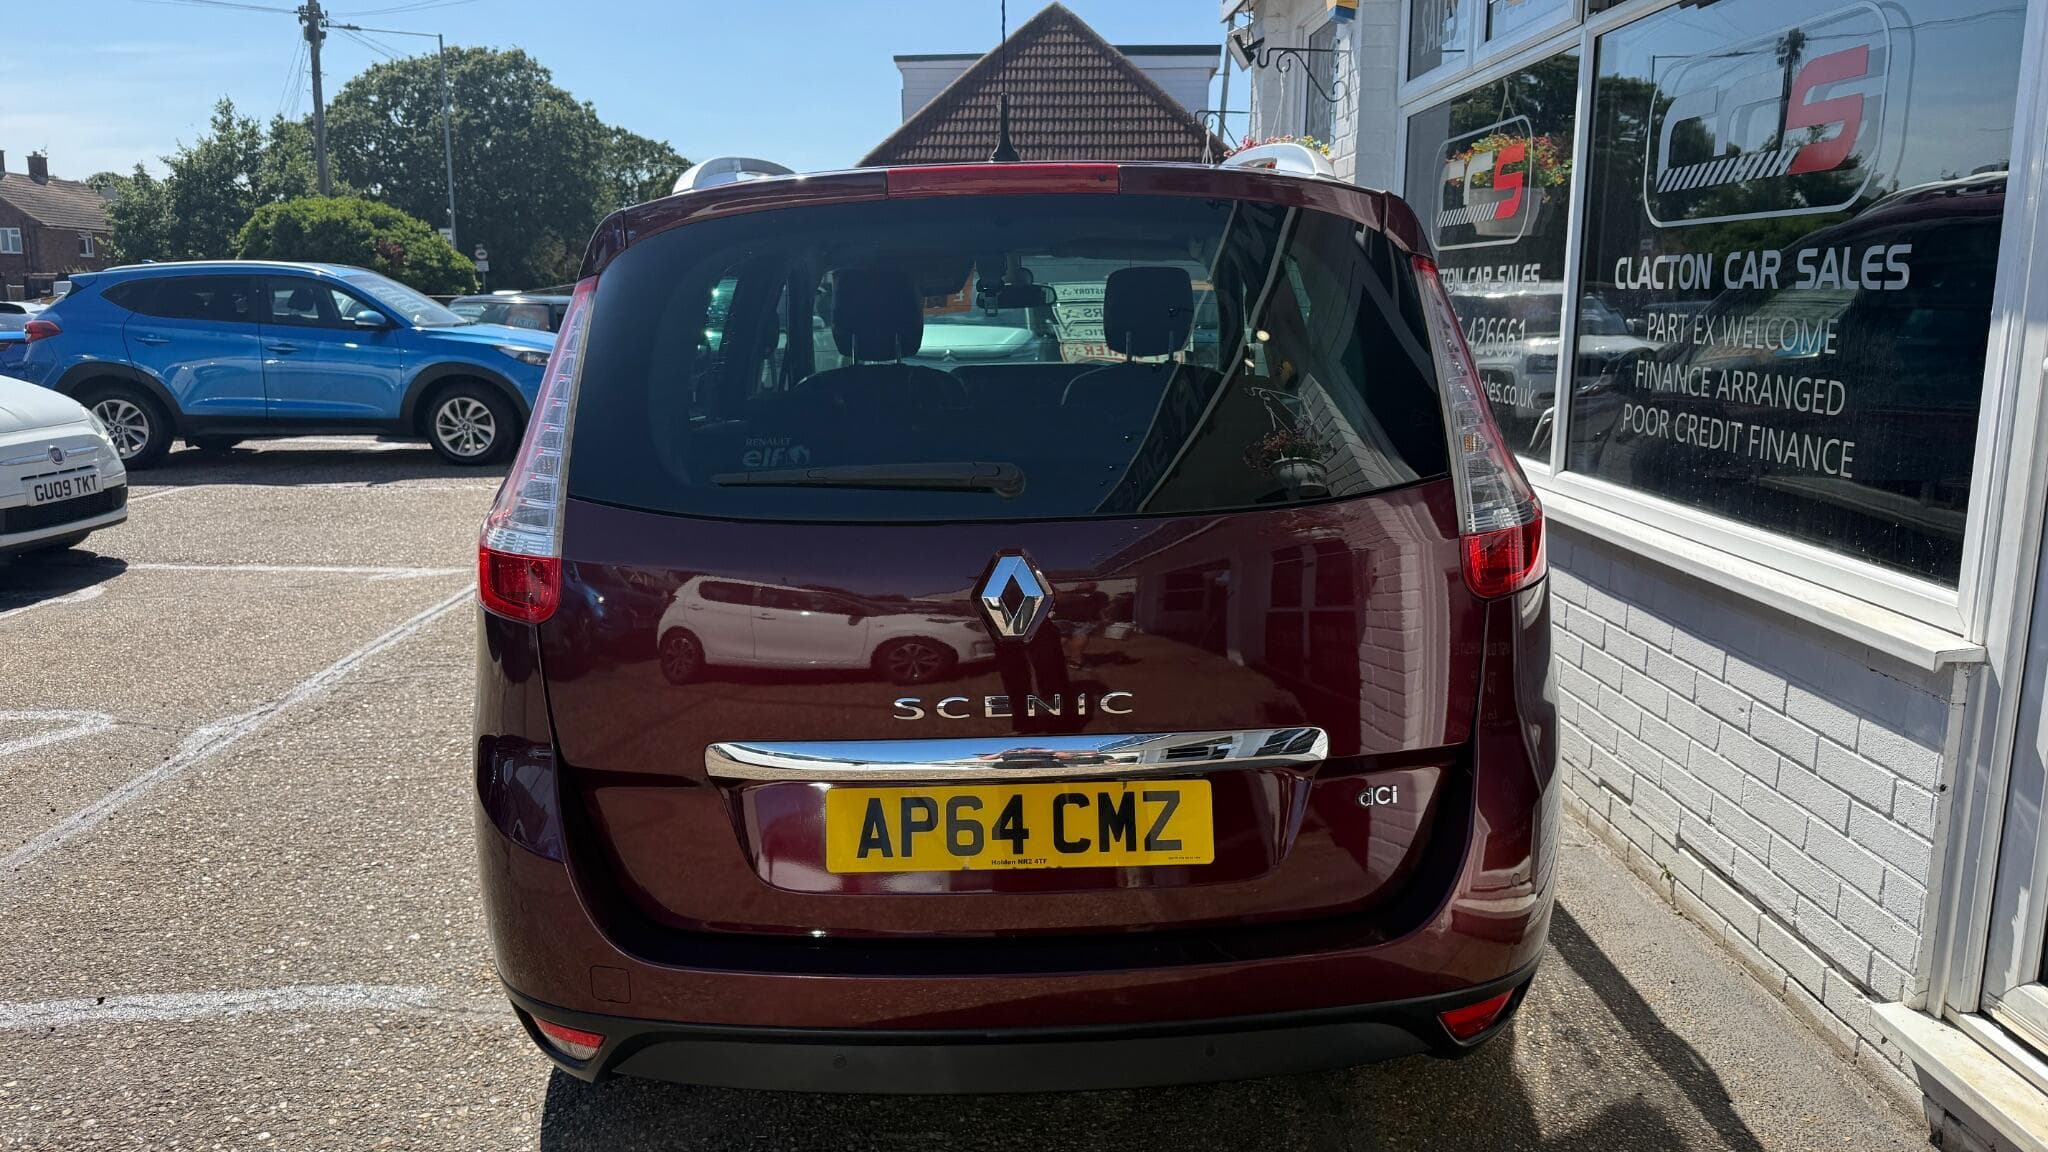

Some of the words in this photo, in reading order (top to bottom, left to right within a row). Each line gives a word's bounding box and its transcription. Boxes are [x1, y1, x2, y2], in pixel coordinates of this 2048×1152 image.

[1438, 267, 1464, 292] TON
[1467, 265, 1493, 289] CAR
[1497, 263, 1542, 290] SALES
[1614, 253, 1713, 290] CLACTON
[1724, 249, 1782, 290] CAR
[1795, 244, 1913, 291] SALES
[1647, 312, 1689, 343] PART
[1693, 314, 1718, 346] EX
[1723, 315, 1840, 355] WELCOME
[1482, 374, 1535, 409] les.co.uk
[1635, 359, 1712, 398] FINANCE
[1715, 369, 1846, 416] ARRANGED
[744, 437, 793, 448] RENAULT
[1623, 403, 1669, 439] POOR
[1674, 412, 1743, 453] CREDIT
[1748, 425, 1856, 478] FINANCE
[34, 480, 72, 502] GU09
[74, 474, 97, 494] TKT
[893, 691, 1133, 720] SCENIC
[1360, 785, 1398, 807] dCi
[856, 794, 1029, 859] AP64
[1053, 790, 1183, 854] CMZ
